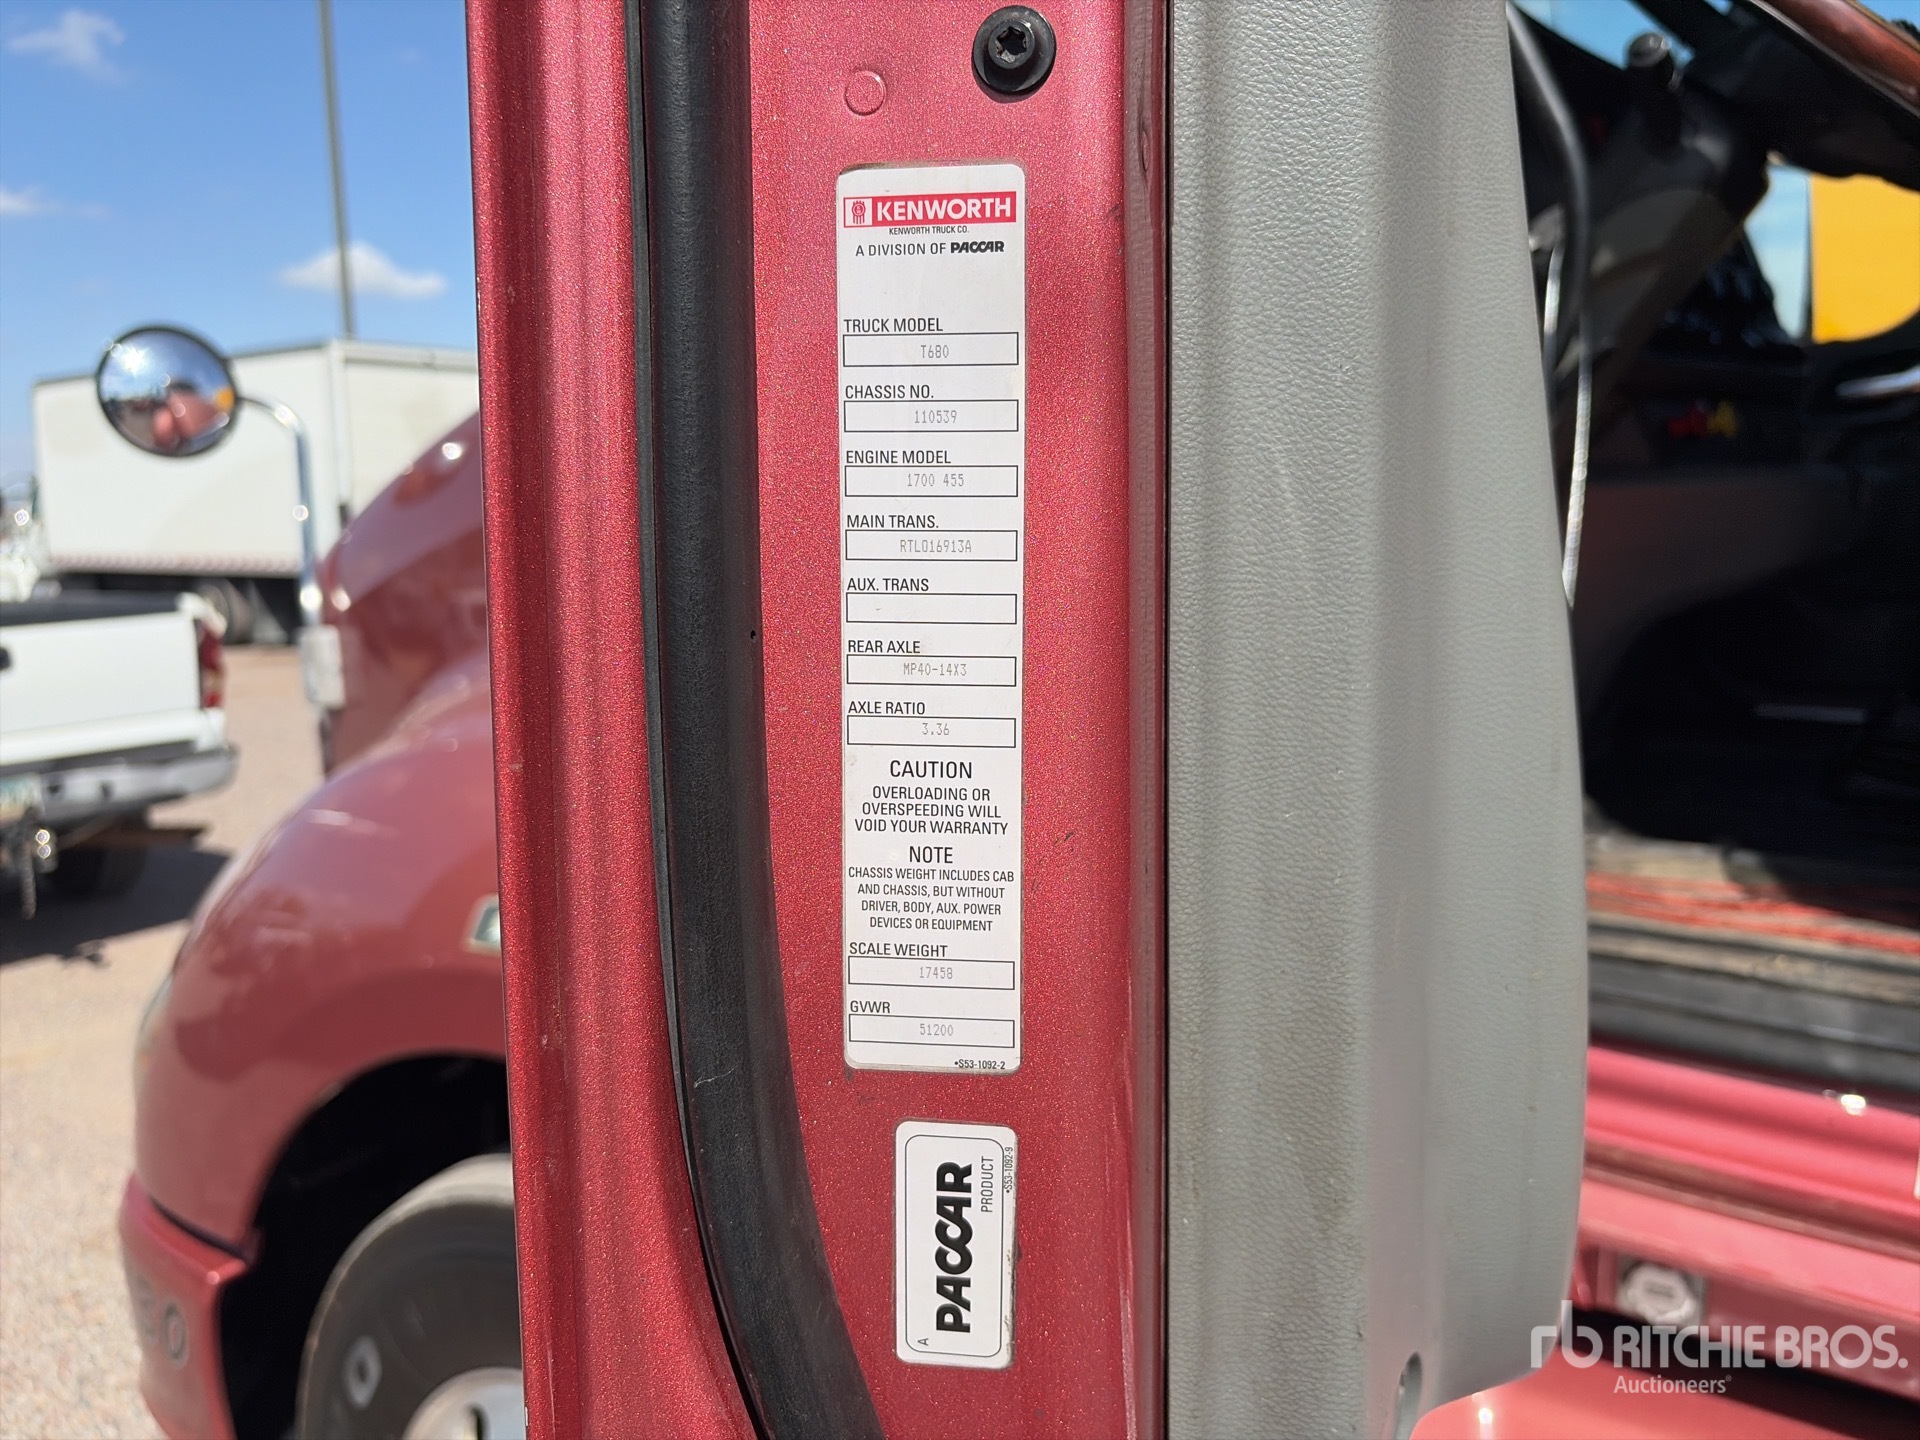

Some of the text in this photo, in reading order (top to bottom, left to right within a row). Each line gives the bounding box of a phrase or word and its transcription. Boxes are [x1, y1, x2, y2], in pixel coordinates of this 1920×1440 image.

[877, 197, 1011, 222] KENWORTH
[889, 225, 969, 235] KENWORTH TRUCK CO.
[855, 241, 1004, 256] A DIVISION OF PACCAR
[844, 318, 943, 333] TRUCK MODEL
[921, 345, 949, 358] T680
[845, 385, 934, 399] CHASSIS NO.
[914, 410, 957, 424] 110539
[846, 450, 951, 464] ENGINE MODEL
[907, 474, 965, 487] 1700 455
[847, 515, 939, 528] MAIN TRANS.
[847, 578, 929, 591] AUX. TRANS
[848, 640, 920, 653] REAR AXLE
[903, 663, 967, 676] MP40-14X3
[848, 701, 925, 714] AXLE RATIO
[922, 723, 950, 735] 3.36
[890, 760, 972, 778] CAUTION
[872, 786, 990, 801] OVERLOADING OR
[862, 802, 1001, 818] OVERSPEEDING WILL
[855, 819, 1008, 835] VOID YOUR WARRANTY
[909, 846, 953, 863] NOTE
[849, 867, 1014, 882] CHASSIS WEIGHT INCLUDES CAB
[858, 884, 1005, 898] AND CHASSIS, BUT WITHOUT
[862, 900, 1001, 915] DRIVER, BODY, AUX. POWER
[870, 917, 993, 931] DEVICES OR EQUIPMENT
[850, 942, 948, 957] SCALE WEIGHT
[919, 967, 953, 979] 17458
[850, 1001, 891, 1013] GVWR
[920, 1024, 953, 1036] 51200
[981, 1156, 993, 1212] PRODUCT
[935, 1162, 973, 1333] PACCAR
[918, 1338, 929, 1346] A
